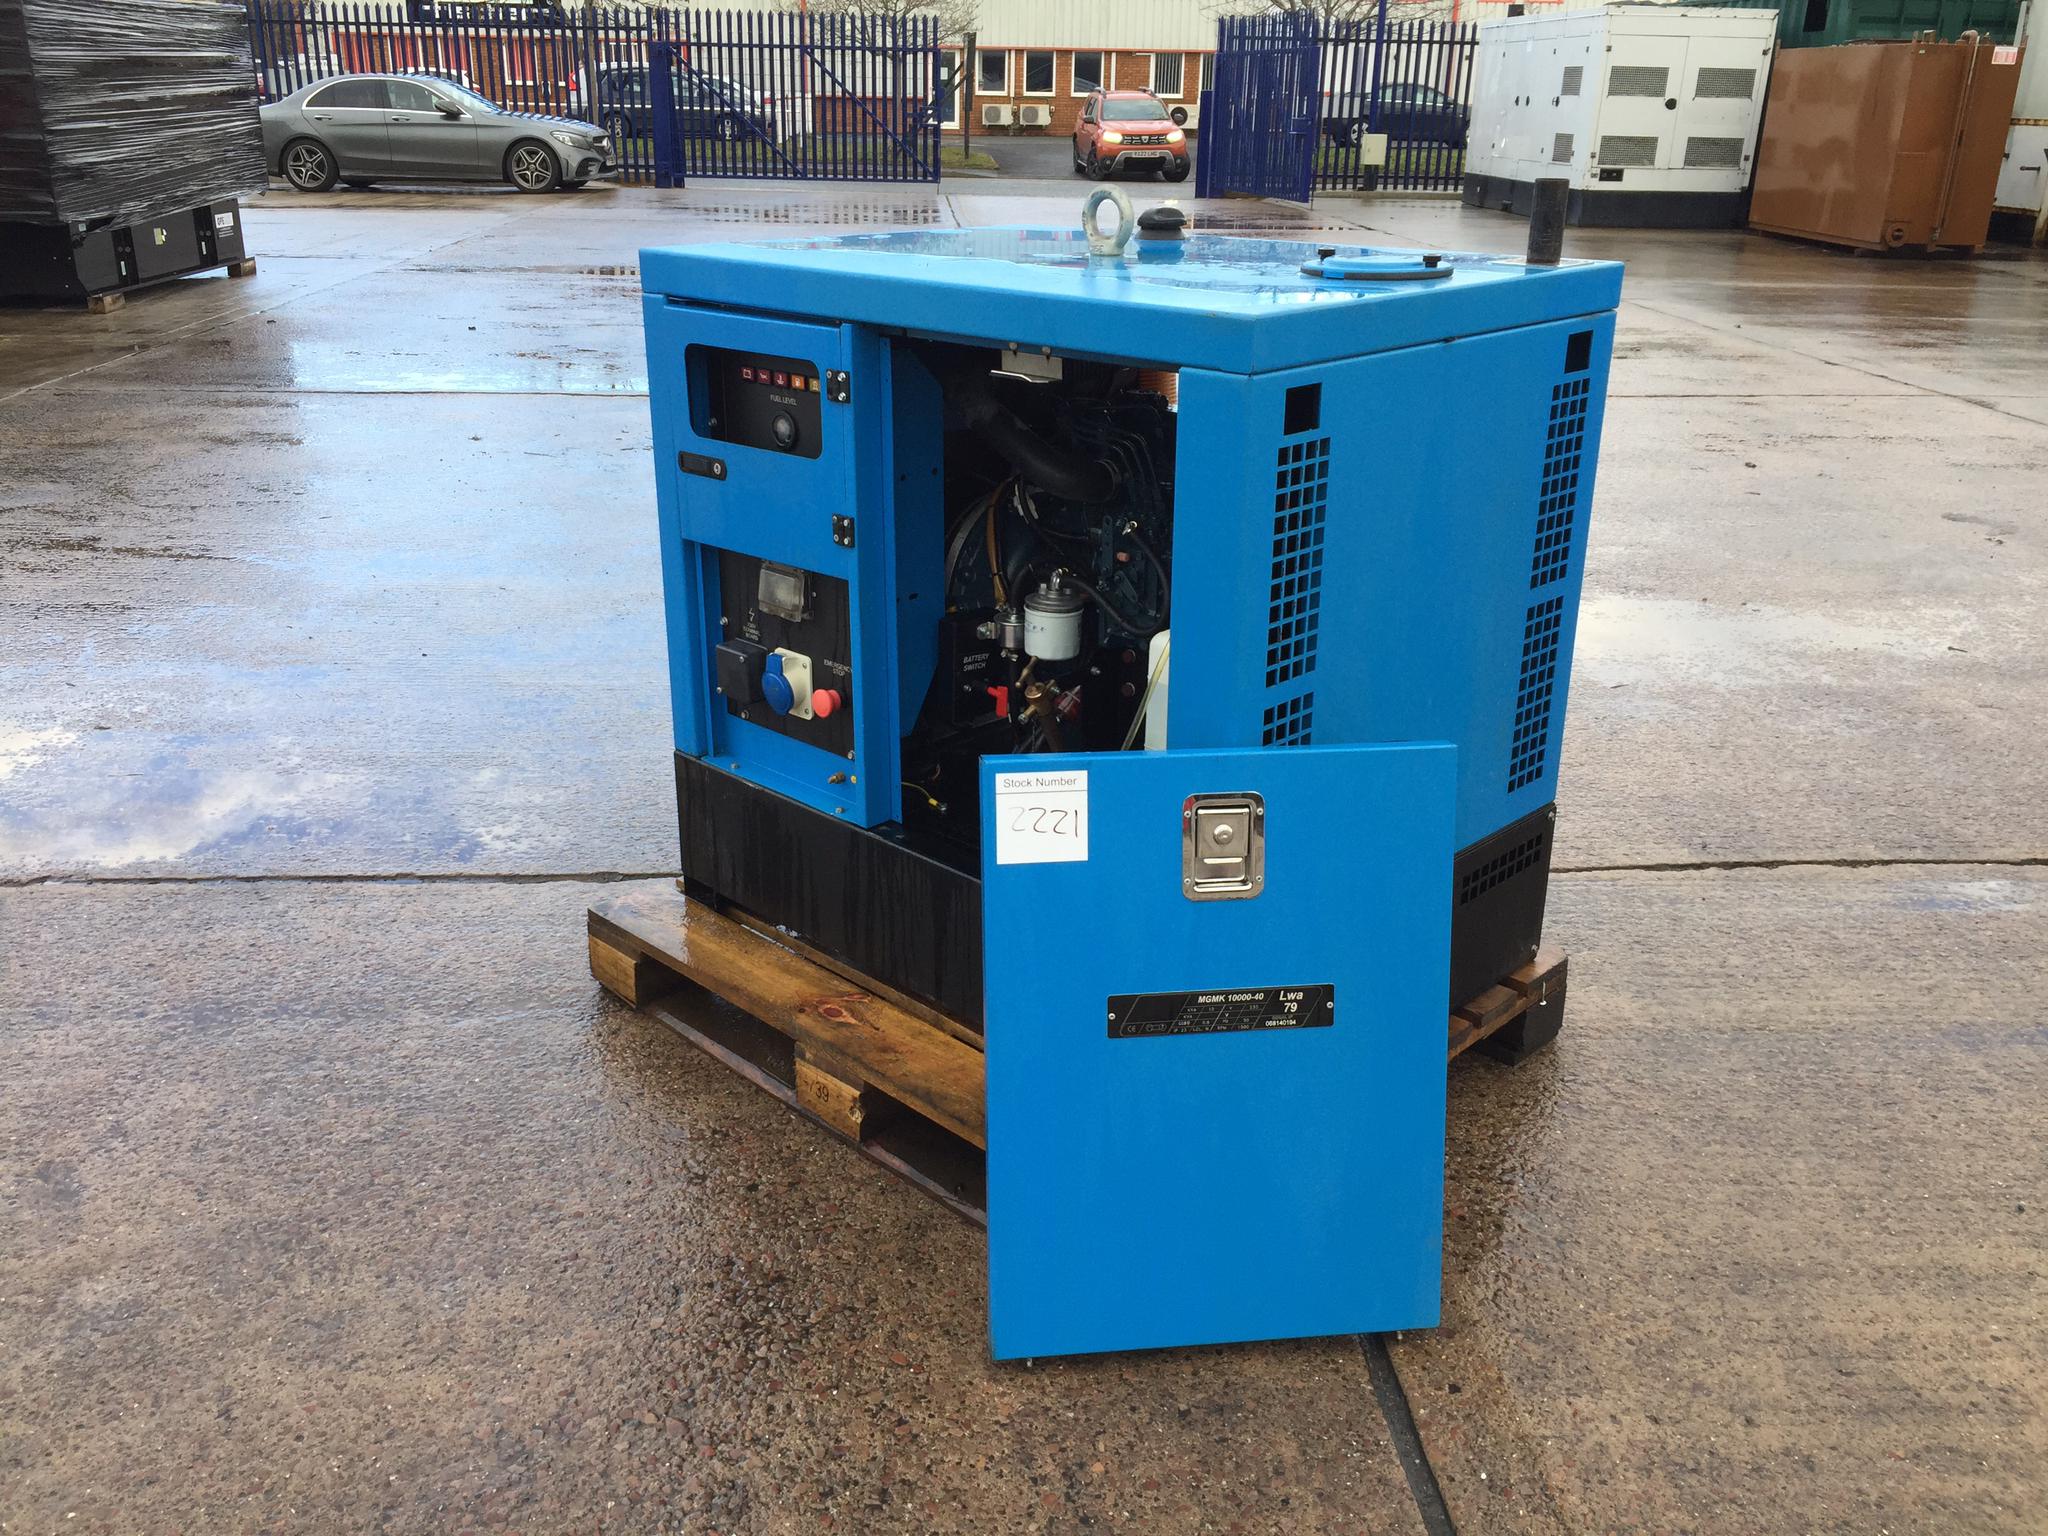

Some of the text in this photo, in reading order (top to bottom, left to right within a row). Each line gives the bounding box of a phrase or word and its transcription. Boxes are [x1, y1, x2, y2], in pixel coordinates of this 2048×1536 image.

[770, 394, 797, 406] FUEL LEVEL
[963, 653, 990, 664] BATTERY
[963, 661, 987, 672] SWITCH
[832, 668, 846, 677] STOP
[1003, 777, 1077, 788] Stock Number
[1008, 806, 1078, 839] 2221
[1197, 992, 1264, 1003] MGMK 10000-40
[1279, 990, 1304, 1001] Lwa
[1284, 1002, 1298, 1013] 79
